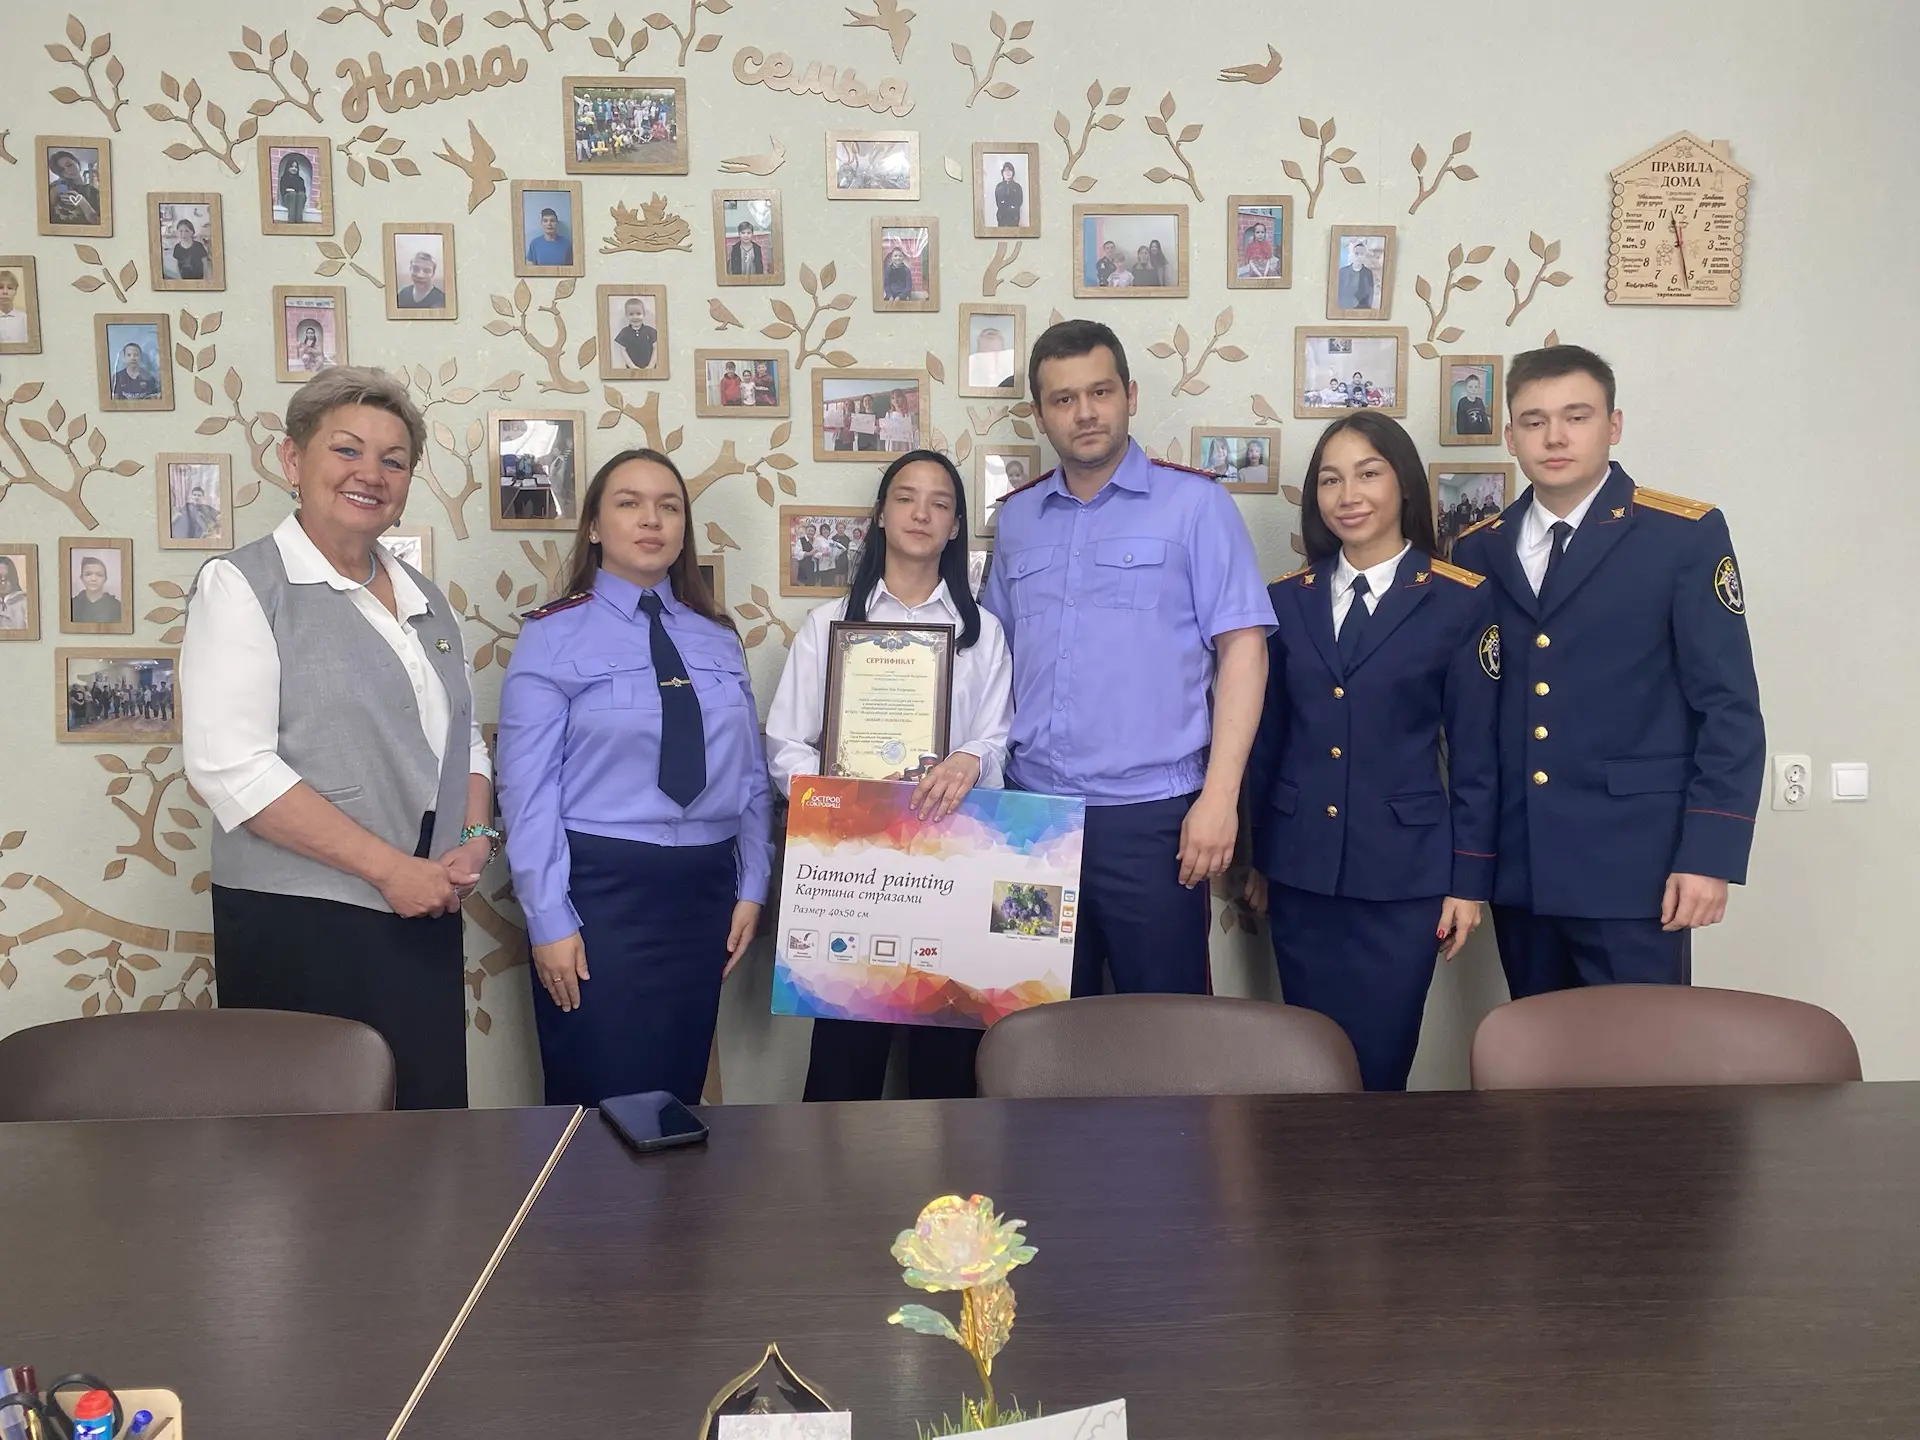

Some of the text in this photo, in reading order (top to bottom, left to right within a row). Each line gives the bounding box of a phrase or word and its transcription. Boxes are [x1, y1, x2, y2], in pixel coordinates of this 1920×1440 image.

[336, 44, 916, 123] Наша семья
[1651, 161, 1714, 173] ПРАВИЛА
[1660, 176, 1701, 188] ДОМА
[1658, 209, 1667, 219] 11
[1674, 204, 1685, 215] 12
[1693, 209, 1698, 219] 1
[1643, 221, 1655, 232] 10
[1703, 221, 1711, 232] 2
[1640, 238, 1647, 249] 9
[1707, 239, 1715, 250] 3
[1643, 256, 1650, 267] 8
[1701, 257, 1709, 268] 4
[1654, 269, 1662, 280] 7
[1671, 274, 1678, 285] 6
[1687, 270, 1695, 281] 5
[866, 657, 916, 665] СЕРТИФИКАТ
[811, 795, 841, 803] ОСТРОВ
[796, 863, 955, 896] Diamond painting
[795, 883, 922, 904] Картина стразами
[792, 904, 826, 917] Размер
